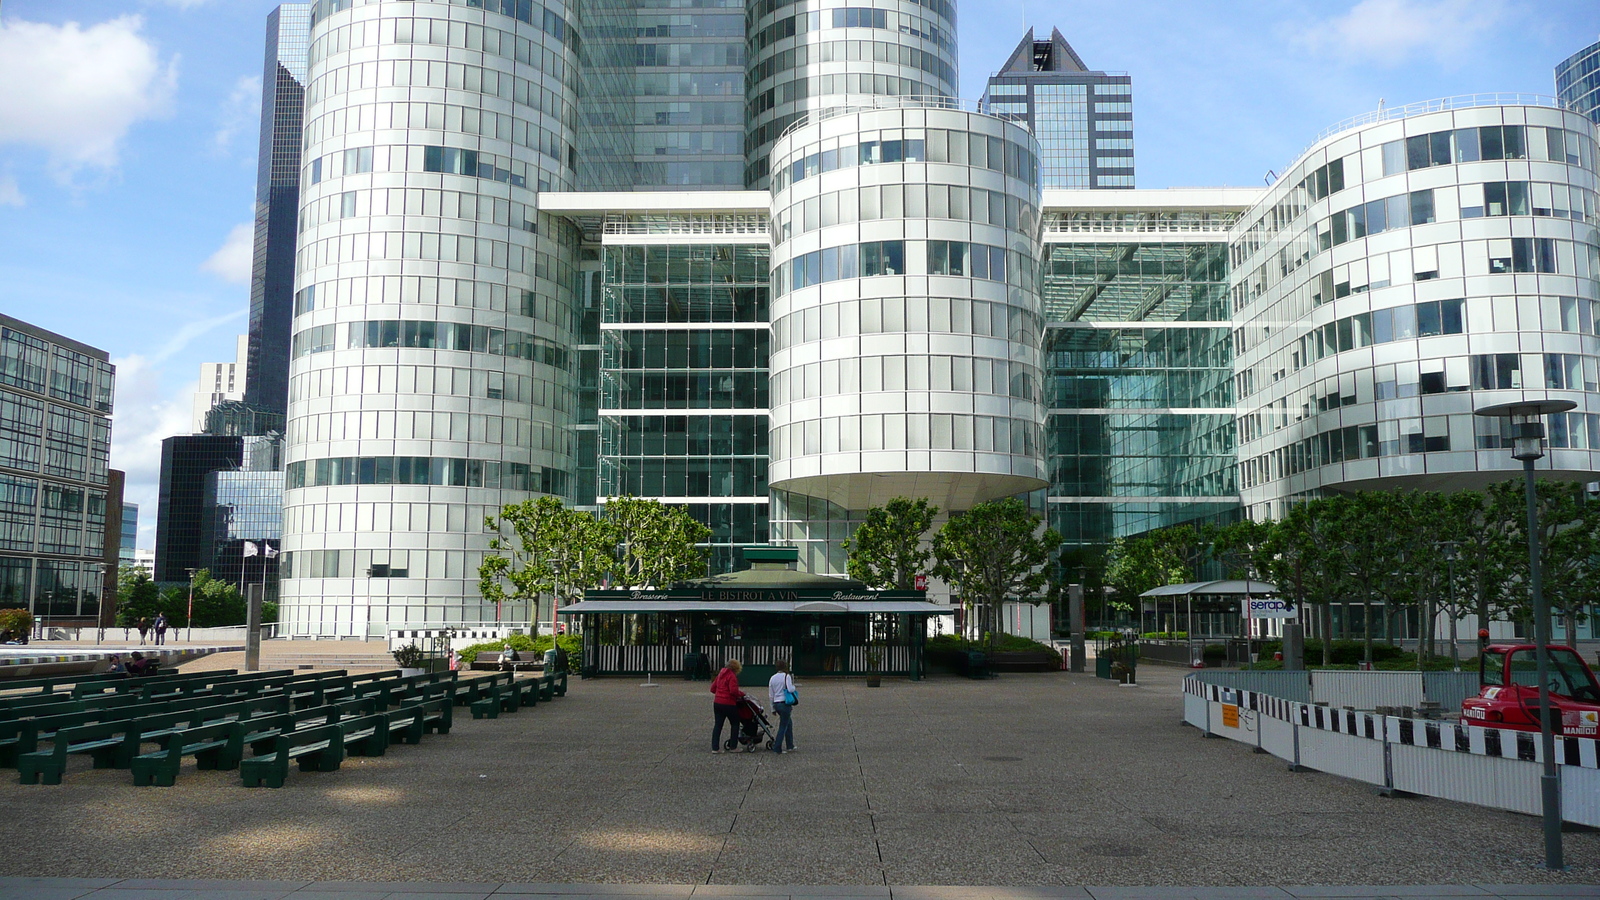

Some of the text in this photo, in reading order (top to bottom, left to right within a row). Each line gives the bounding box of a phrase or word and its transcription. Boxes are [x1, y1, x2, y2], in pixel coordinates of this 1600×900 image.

[630, 591, 669, 600] Brasserie
[701, 591, 798, 600] LE BISTROT A VIN
[831, 591, 880, 600] Restaurant
[1563, 724, 1597, 735] MANITOU
